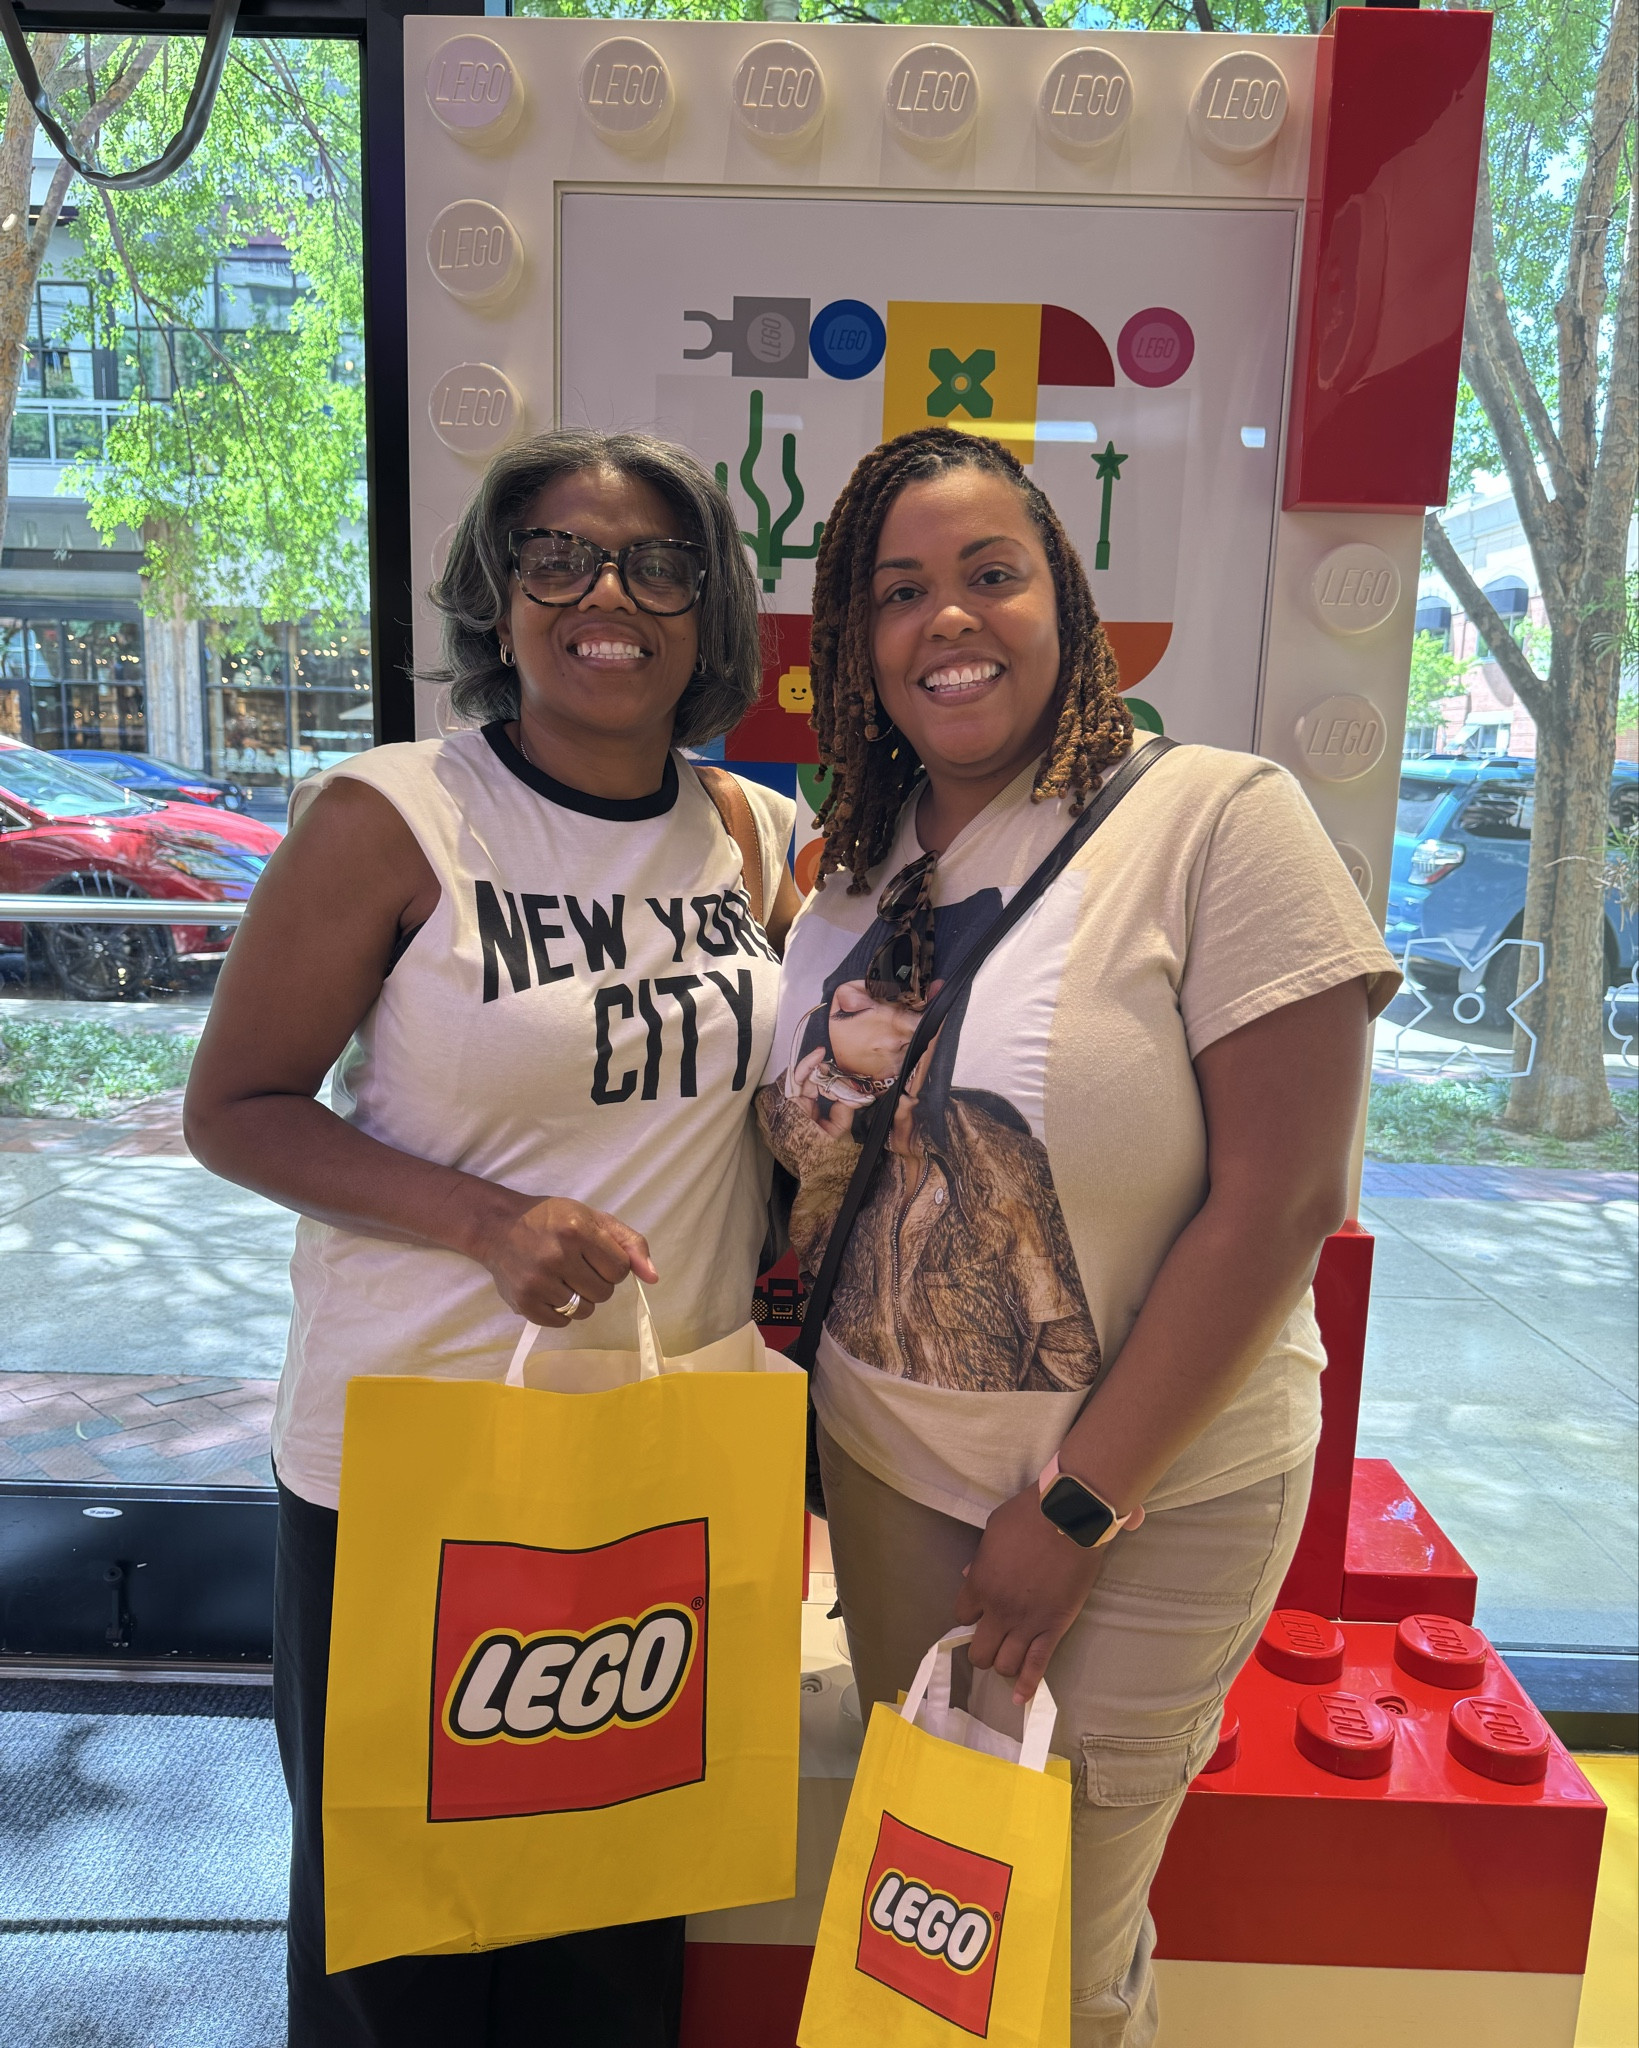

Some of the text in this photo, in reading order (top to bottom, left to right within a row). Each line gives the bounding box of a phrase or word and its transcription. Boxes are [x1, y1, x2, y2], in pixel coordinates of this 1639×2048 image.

[435, 61, 506, 103] LEGO
[588, 63, 660, 105] LEGO
[743, 66, 815, 109] LEGO
[897, 70, 970, 112] LEGO
[1051, 74, 1125, 116] LEGO
[1207, 78, 1281, 120] LEGO
[438, 225, 505, 270] LEGO
[761, 317, 782, 358] LEGO
[828, 329, 868, 351] LEGO
[1135, 337, 1175, 358] LEGO
[439, 387, 507, 427] LEGO
[1321, 568, 1392, 606] LEGO
[1307, 719, 1379, 756] LEGO
[475, 880, 627, 1004] NEW
[591, 968, 753, 1106] CITY
[1276, 1612, 1326, 1650] LEGO
[1413, 1616, 1470, 1655] LEGO
[453, 1612, 690, 1736] LEGO
[1318, 1693, 1375, 1741] LEGO
[1468, 1700, 1532, 1746] LEGO
[871, 1874, 990, 1968] LEGO
